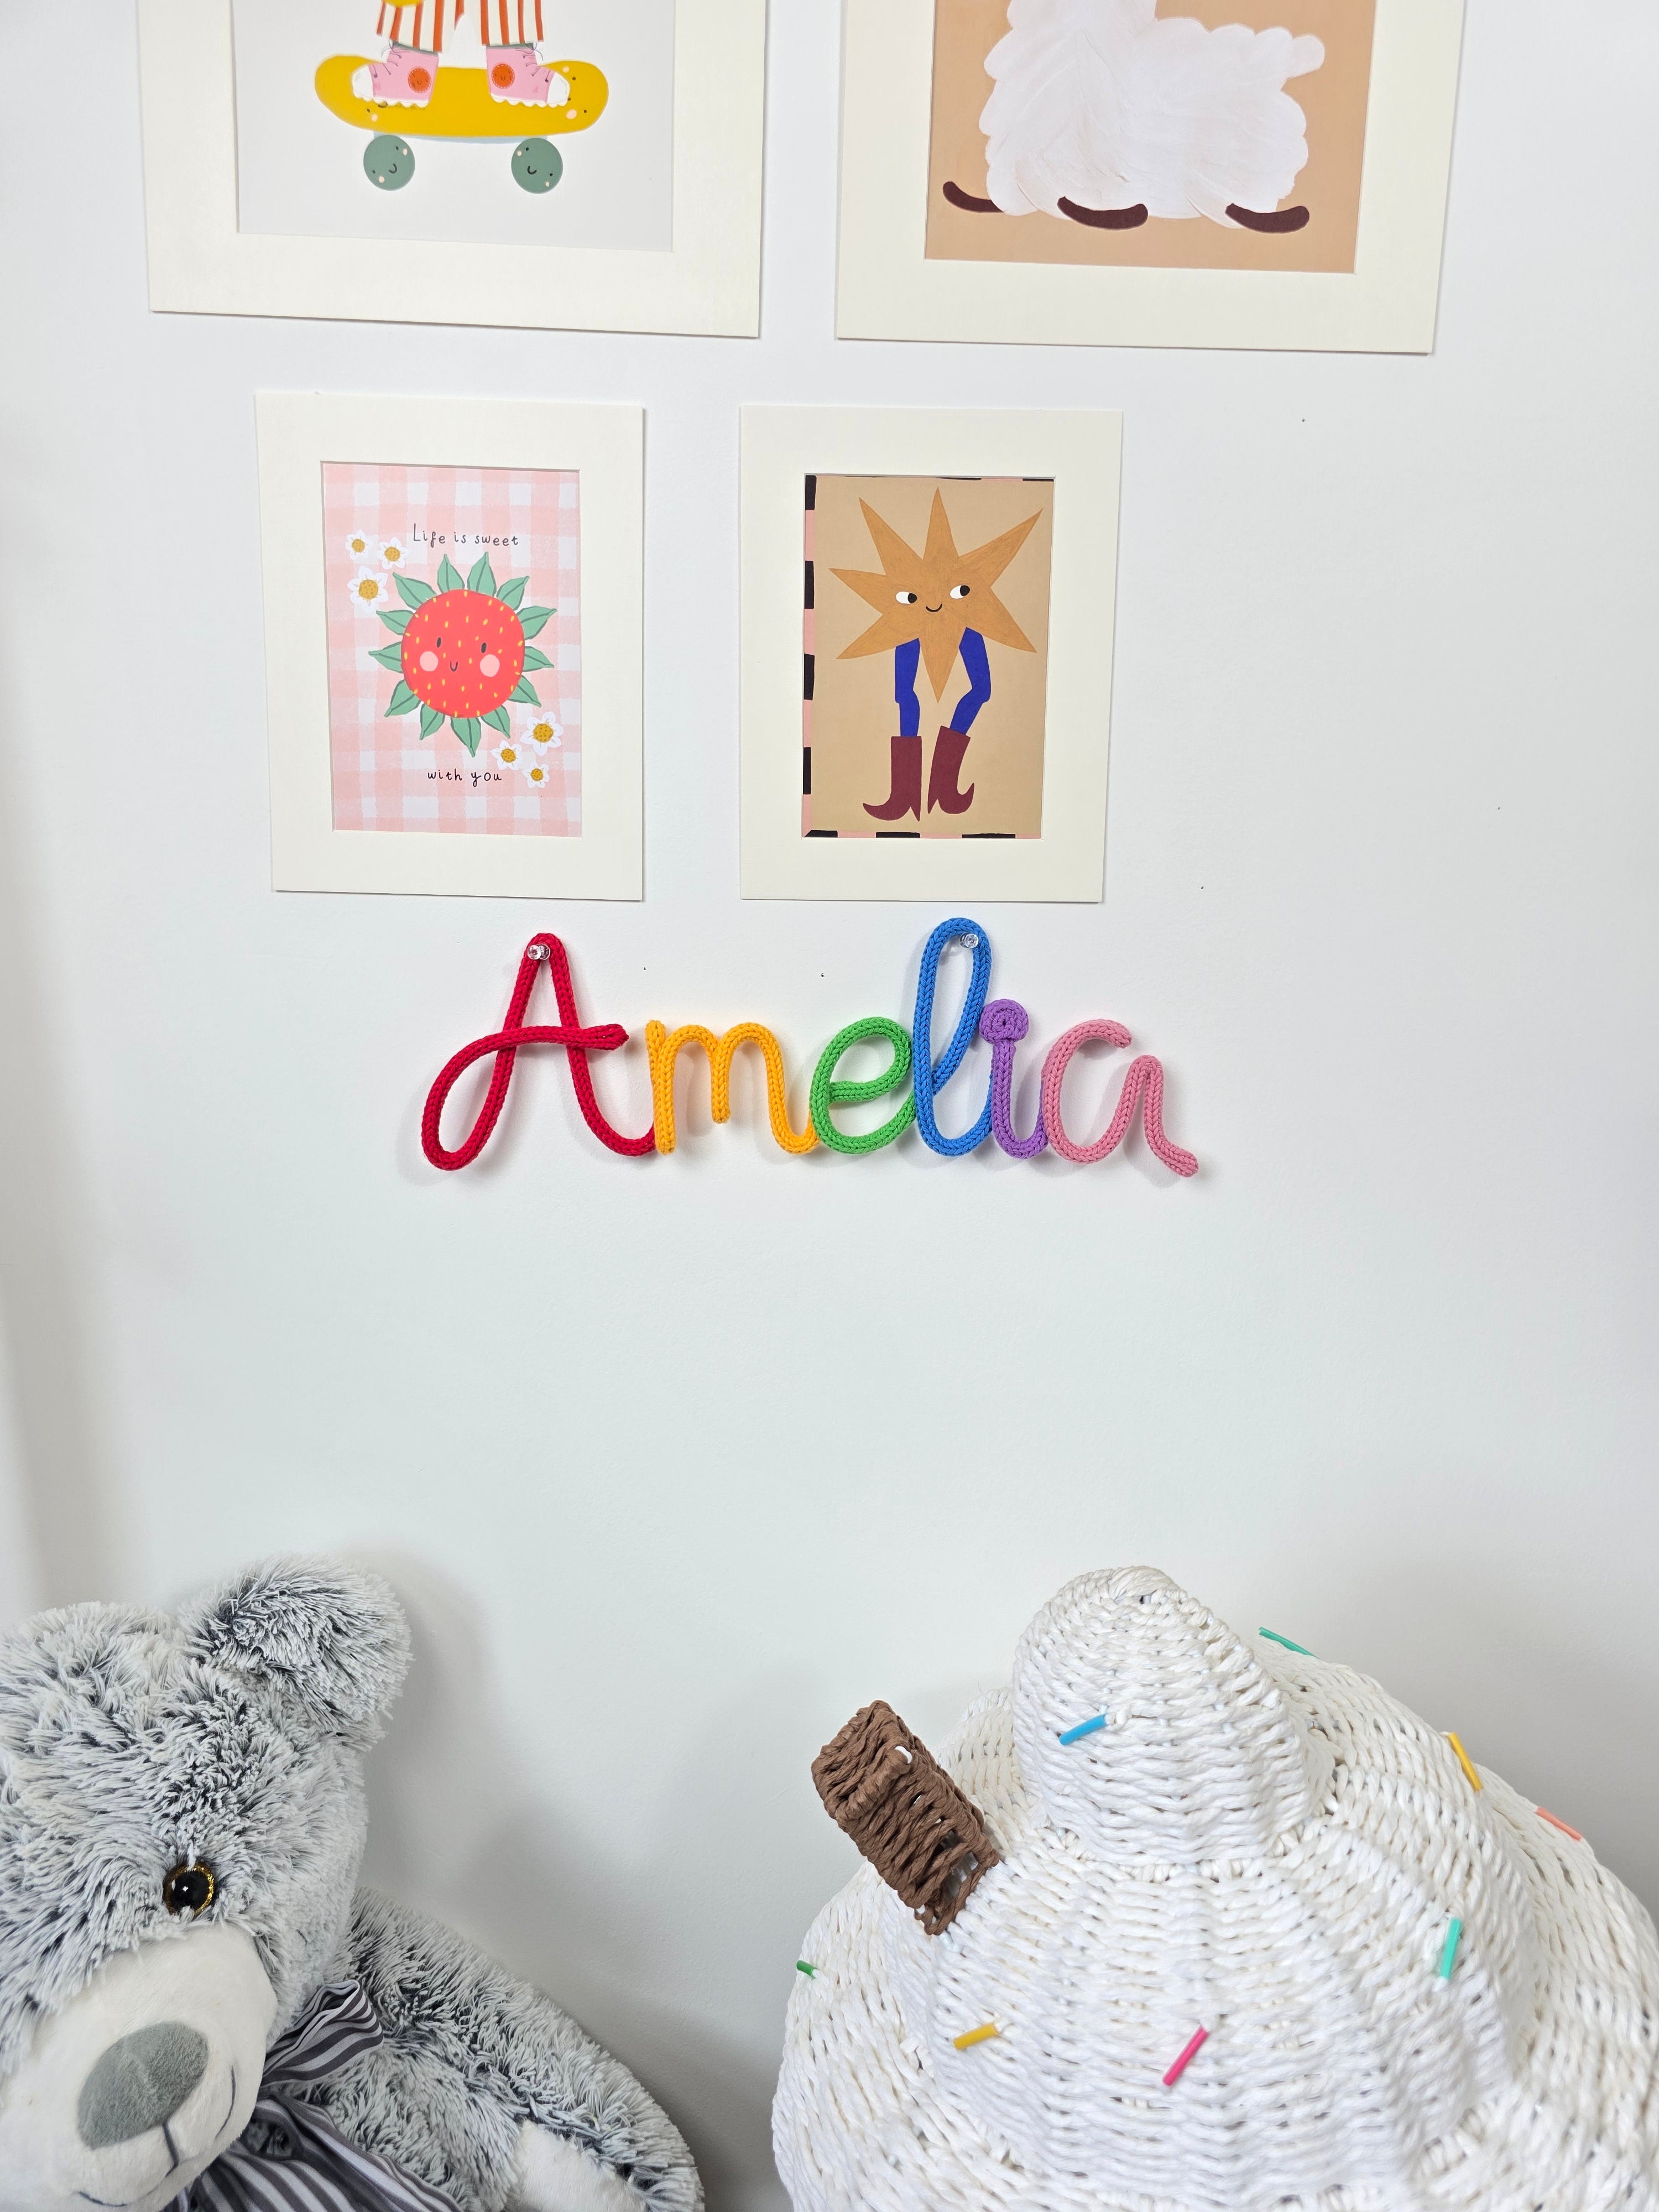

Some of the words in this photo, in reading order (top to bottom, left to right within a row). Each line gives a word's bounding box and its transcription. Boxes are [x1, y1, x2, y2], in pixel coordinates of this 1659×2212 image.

[413, 523, 446, 548] Life
[453, 531, 466, 544] is
[474, 535, 519, 546] sweet
[427, 768, 463, 781] with
[471, 771, 502, 787] you
[421, 917, 1198, 1177] Amelia
